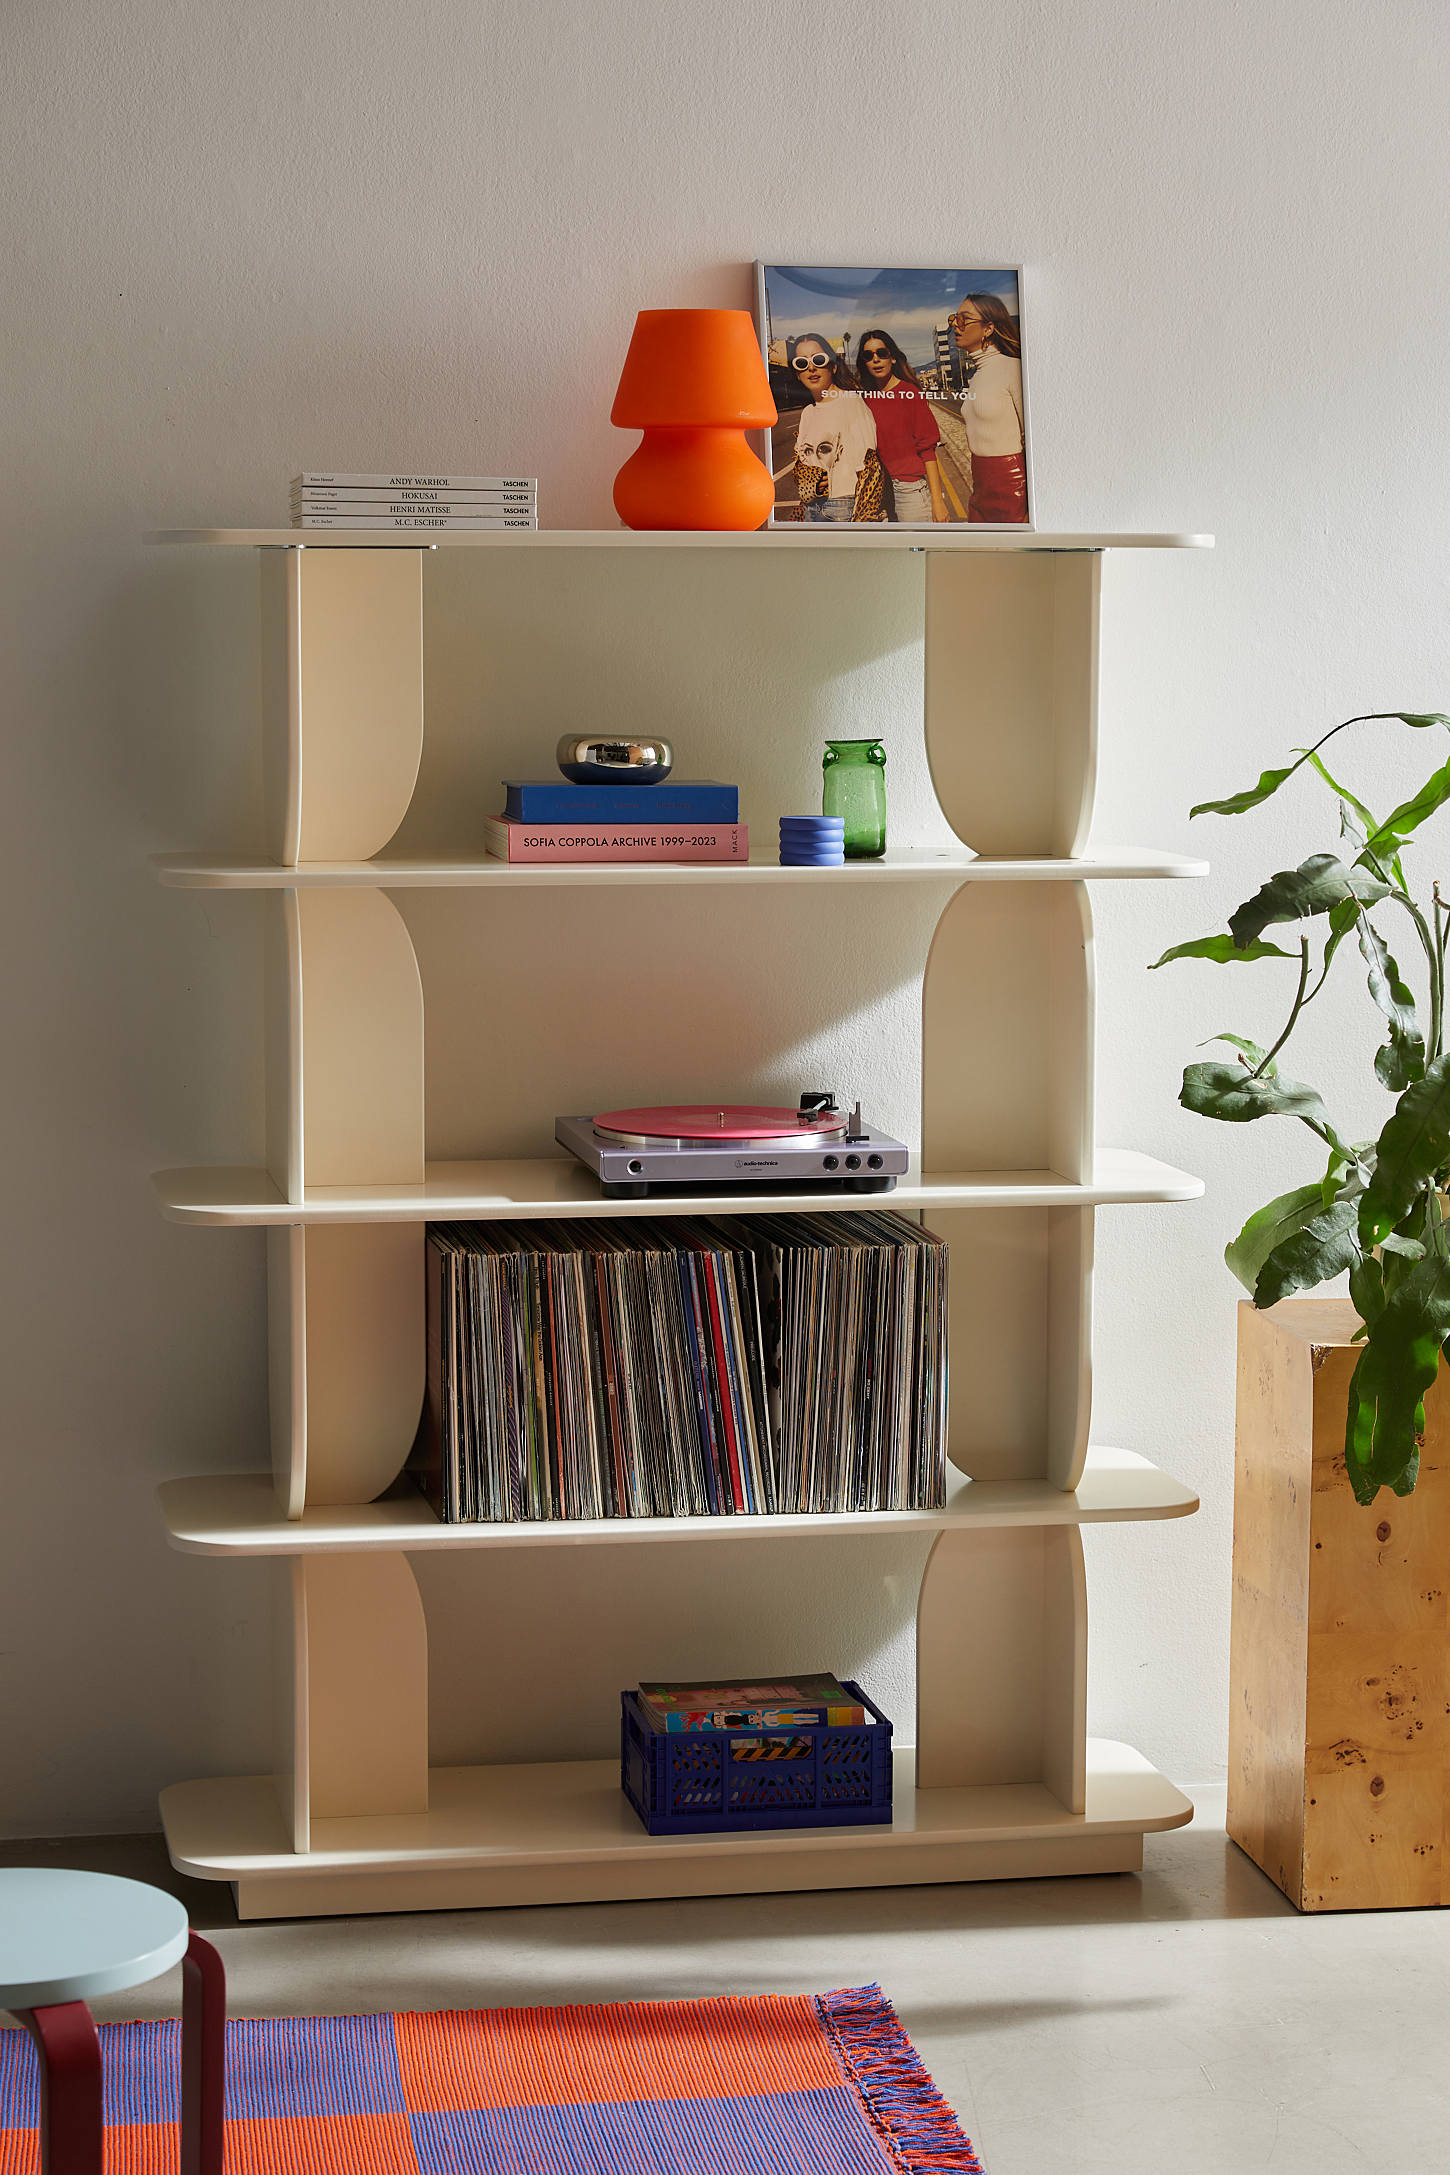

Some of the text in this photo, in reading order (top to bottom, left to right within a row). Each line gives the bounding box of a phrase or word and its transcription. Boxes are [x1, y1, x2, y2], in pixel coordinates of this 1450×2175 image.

[821, 390, 977, 401] SOMETHING TO TELL YOU
[414, 478, 450, 487] WARHOL
[401, 492, 438, 500] HOKUSAI
[523, 837, 556, 848] SOFIA
[558, 837, 609, 848] COPPOLA
[611, 836, 657, 847] ARCHIVE
